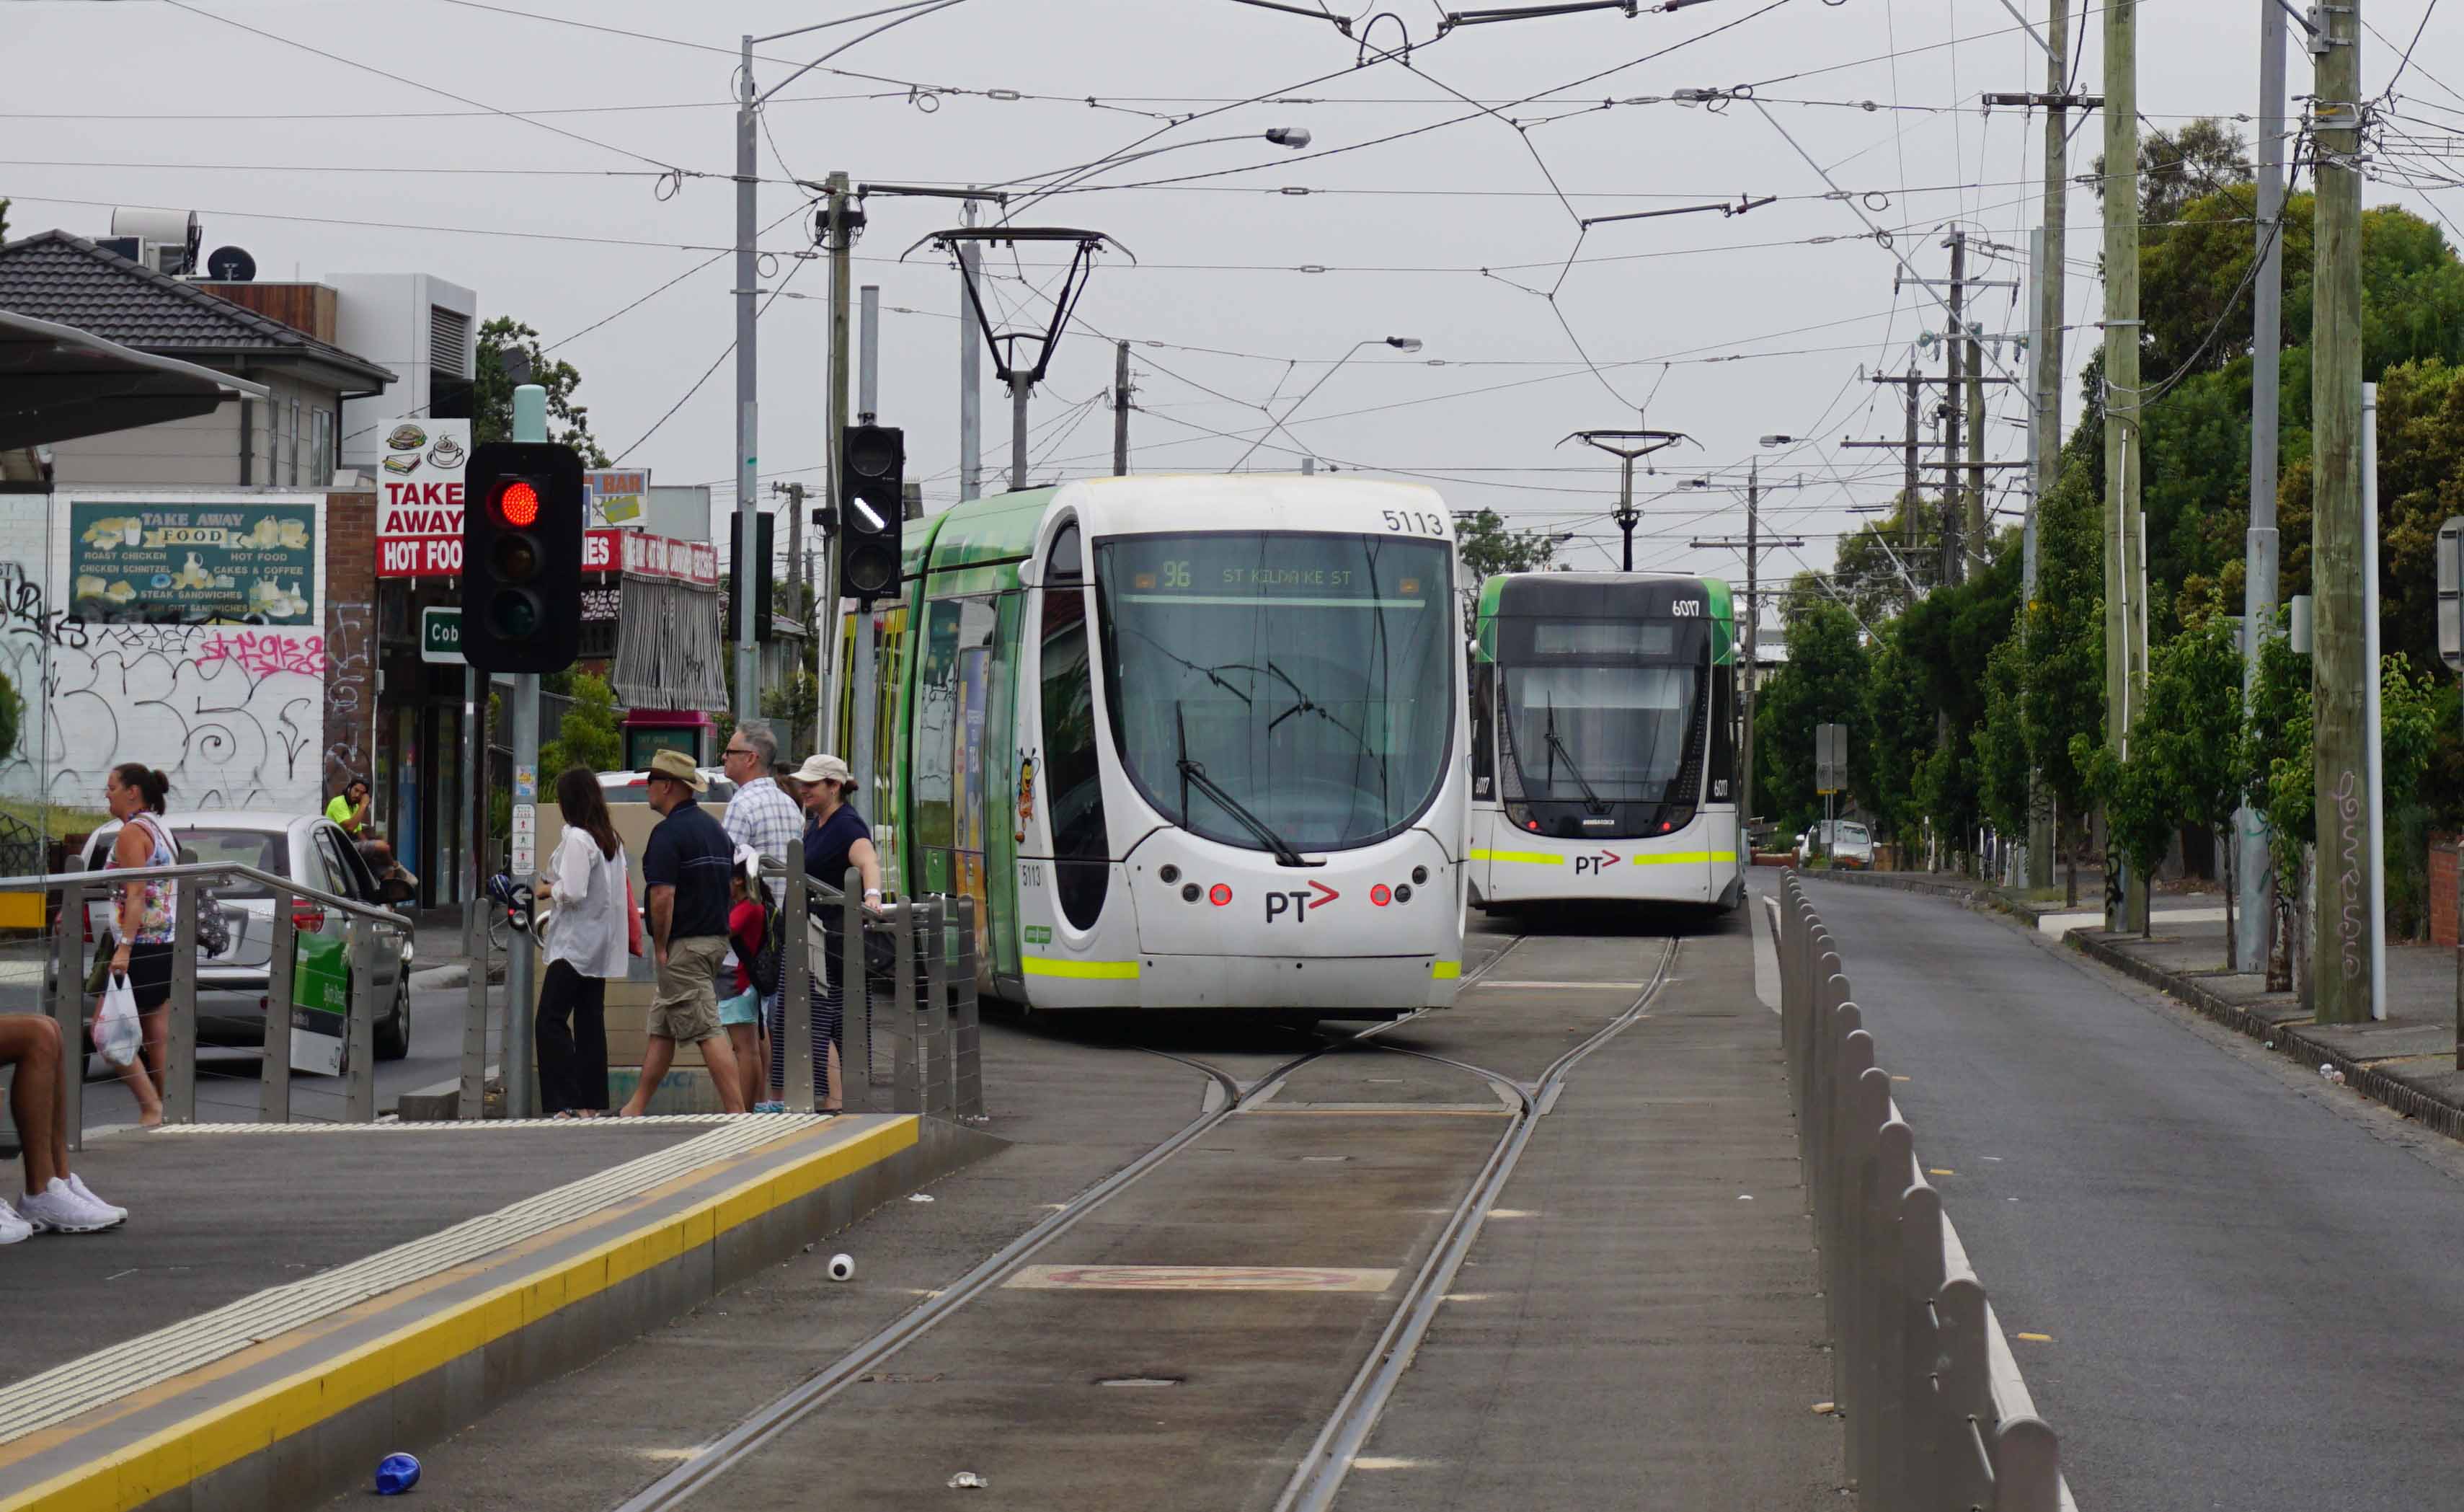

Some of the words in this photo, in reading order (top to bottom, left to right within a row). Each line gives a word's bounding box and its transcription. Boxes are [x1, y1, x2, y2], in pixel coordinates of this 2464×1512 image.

[385, 482, 464, 505] TAKE
[141, 513, 189, 526] TAKE
[196, 513, 244, 526] AWAY
[385, 510, 464, 532] AWAY
[1382, 510, 1443, 535] 5113
[164, 529, 222, 541] FOOD
[84, 552, 118, 560] ROAST
[121, 552, 167, 560] CHICKEN
[230, 552, 252, 561] HOT
[258, 552, 288, 561] FOOD
[384, 541, 420, 570] HOT
[80, 565, 119, 573] CHICKEN
[123, 565, 171, 573] SCHNITZEL
[265, 566, 303, 575] COFFEE
[1164, 560, 1190, 588] 96
[1223, 569, 1244, 583] ST
[1331, 570, 1352, 585] ST
[140, 590, 173, 599] STEAK
[178, 591, 242, 600] SANDWICHES
[1672, 600, 1699, 616] 6017
[1023, 865, 1041, 887] 5113
